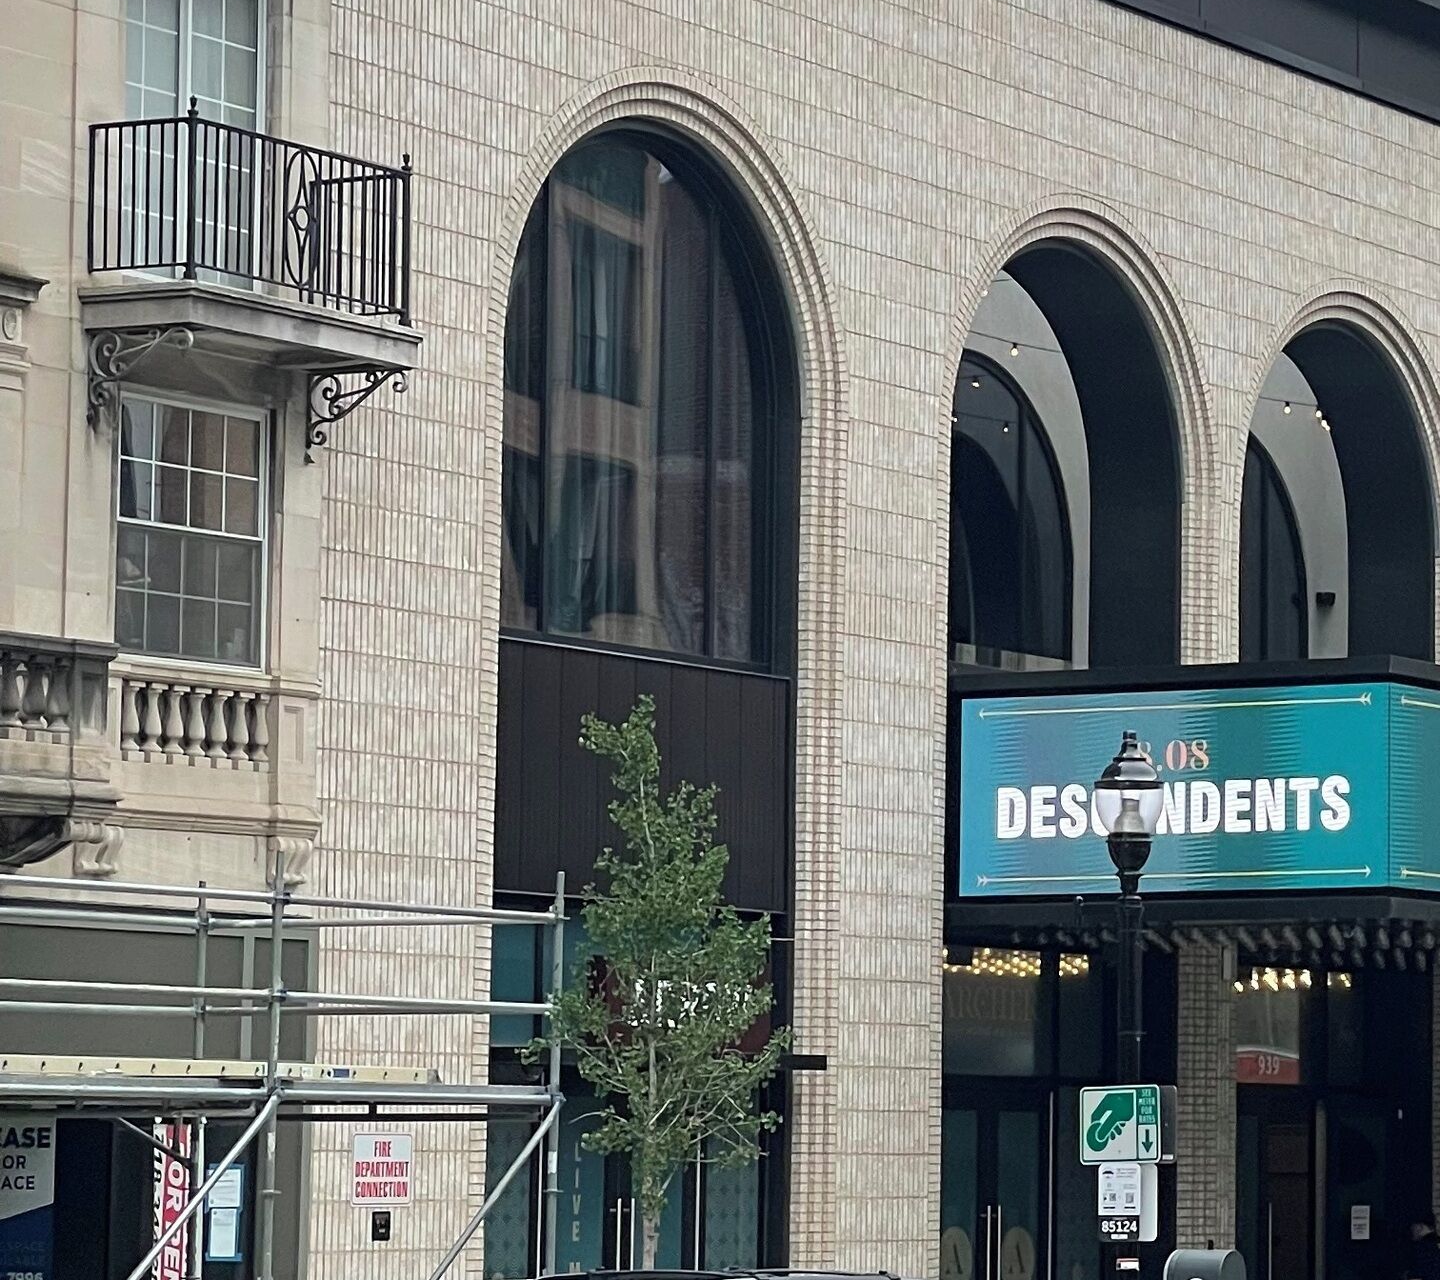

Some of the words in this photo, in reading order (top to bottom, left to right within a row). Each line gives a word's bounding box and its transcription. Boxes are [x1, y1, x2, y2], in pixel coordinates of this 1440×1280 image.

[996, 774, 1351, 840] DESNDENTS
[1258, 1055, 1280, 1075] 939
[373, 1141, 392, 1158] FIRE
[355, 1161, 410, 1178] DEPARTMENT
[355, 1181, 408, 1198] CONNECTION
[572, 1142, 582, 1242] LIVE
[1101, 1220, 1138, 1233] 85124
